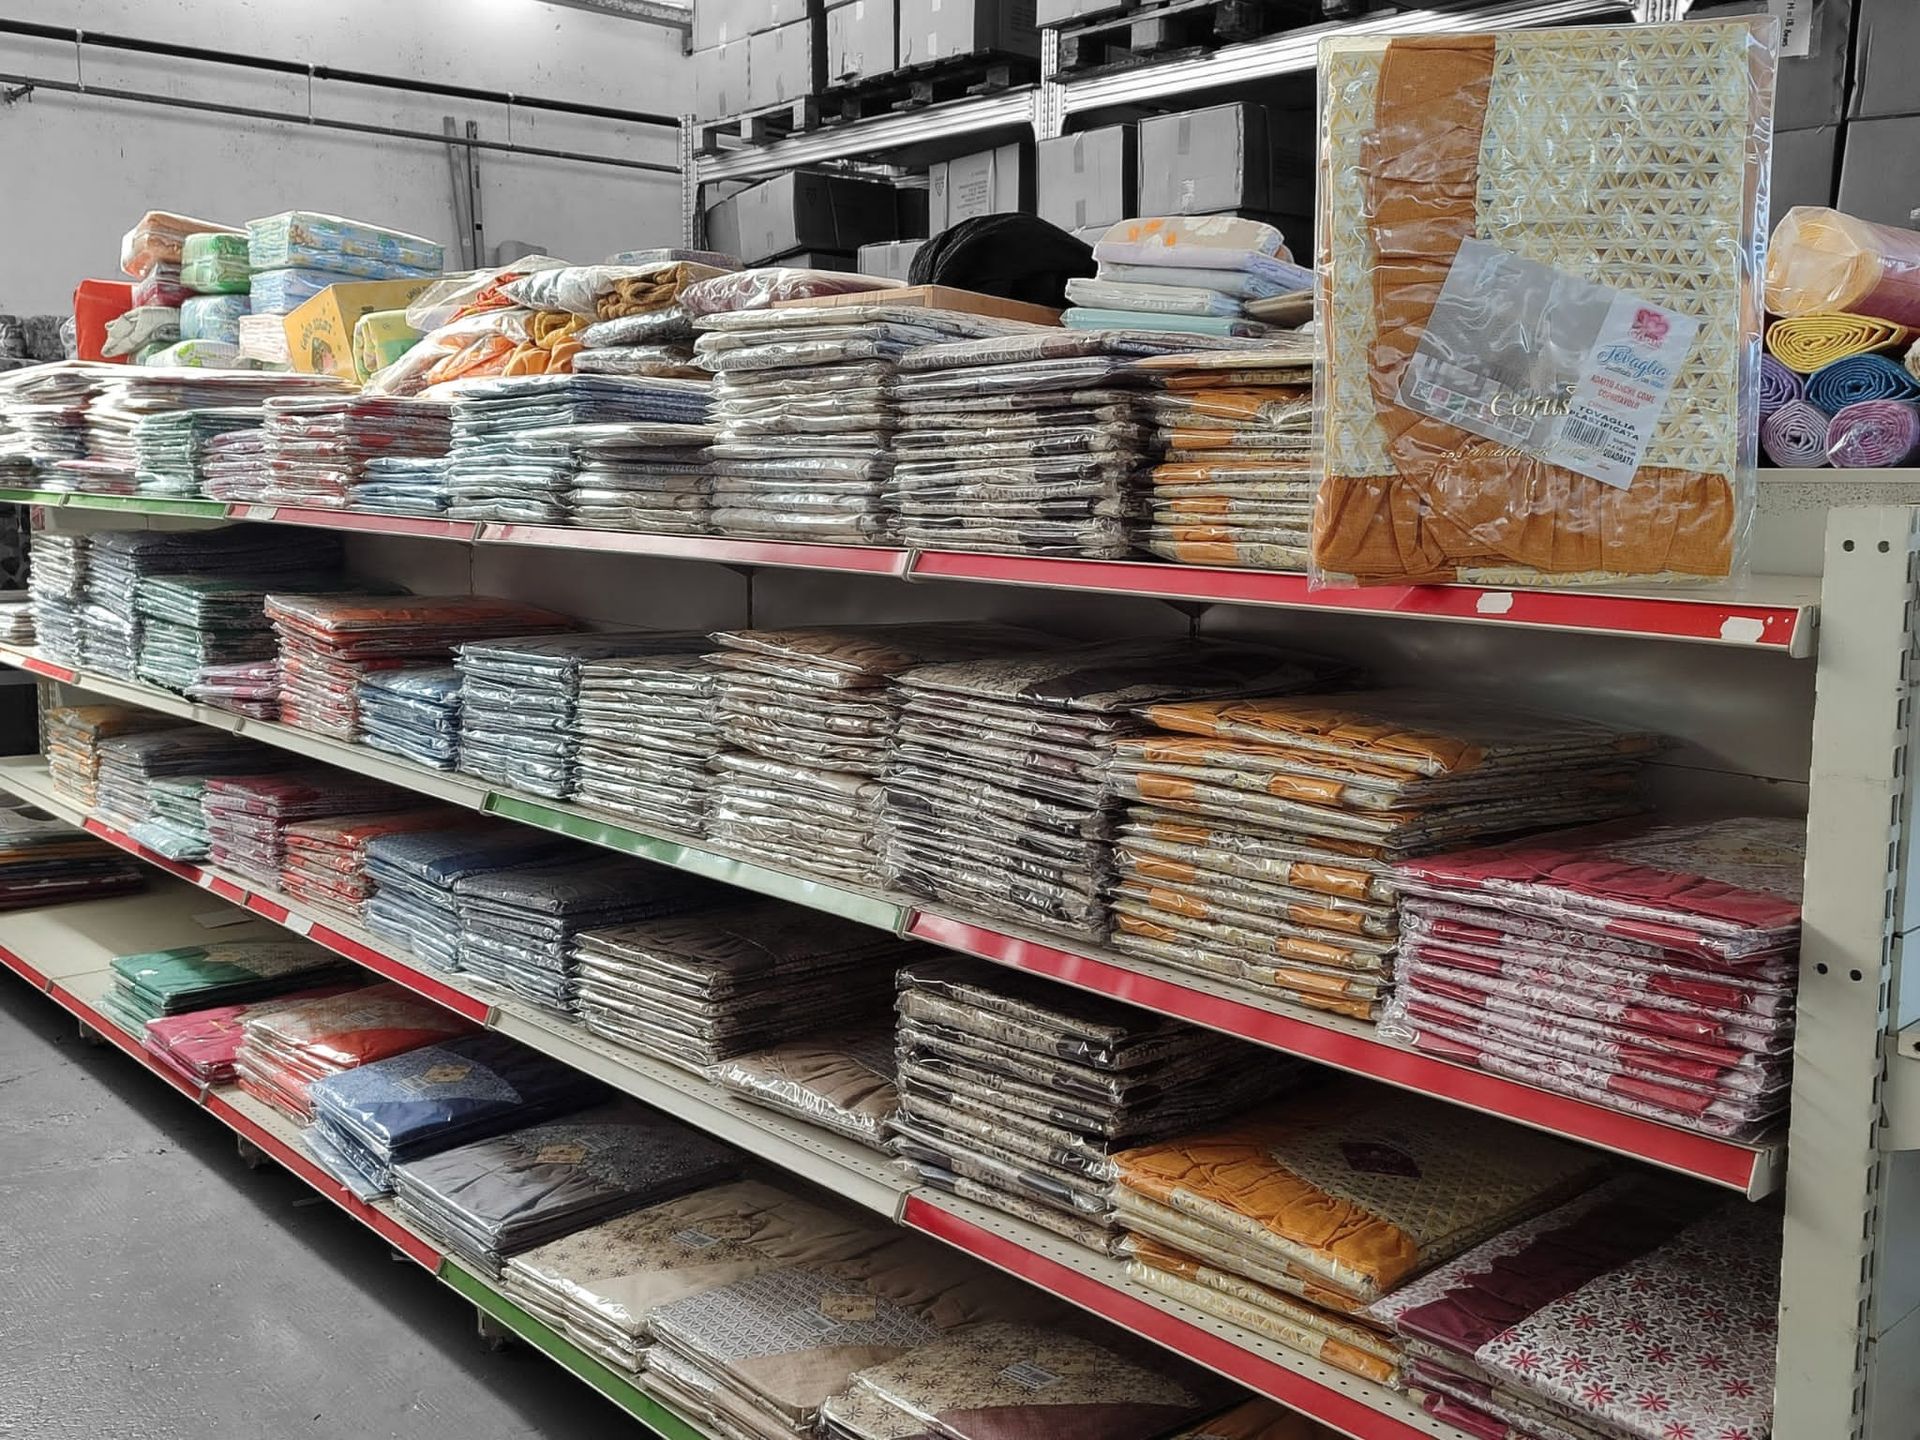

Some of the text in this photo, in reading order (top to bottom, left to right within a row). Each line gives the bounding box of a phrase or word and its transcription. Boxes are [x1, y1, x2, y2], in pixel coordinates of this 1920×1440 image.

[1597, 344, 1667, 378] Tovaglia
[1637, 391, 1656, 404] COME
[1569, 410, 1639, 440] PLASTIFICATA
[1579, 405, 1636, 431] TOVAGLIA
[1603, 448, 1634, 465] QUADRATA
